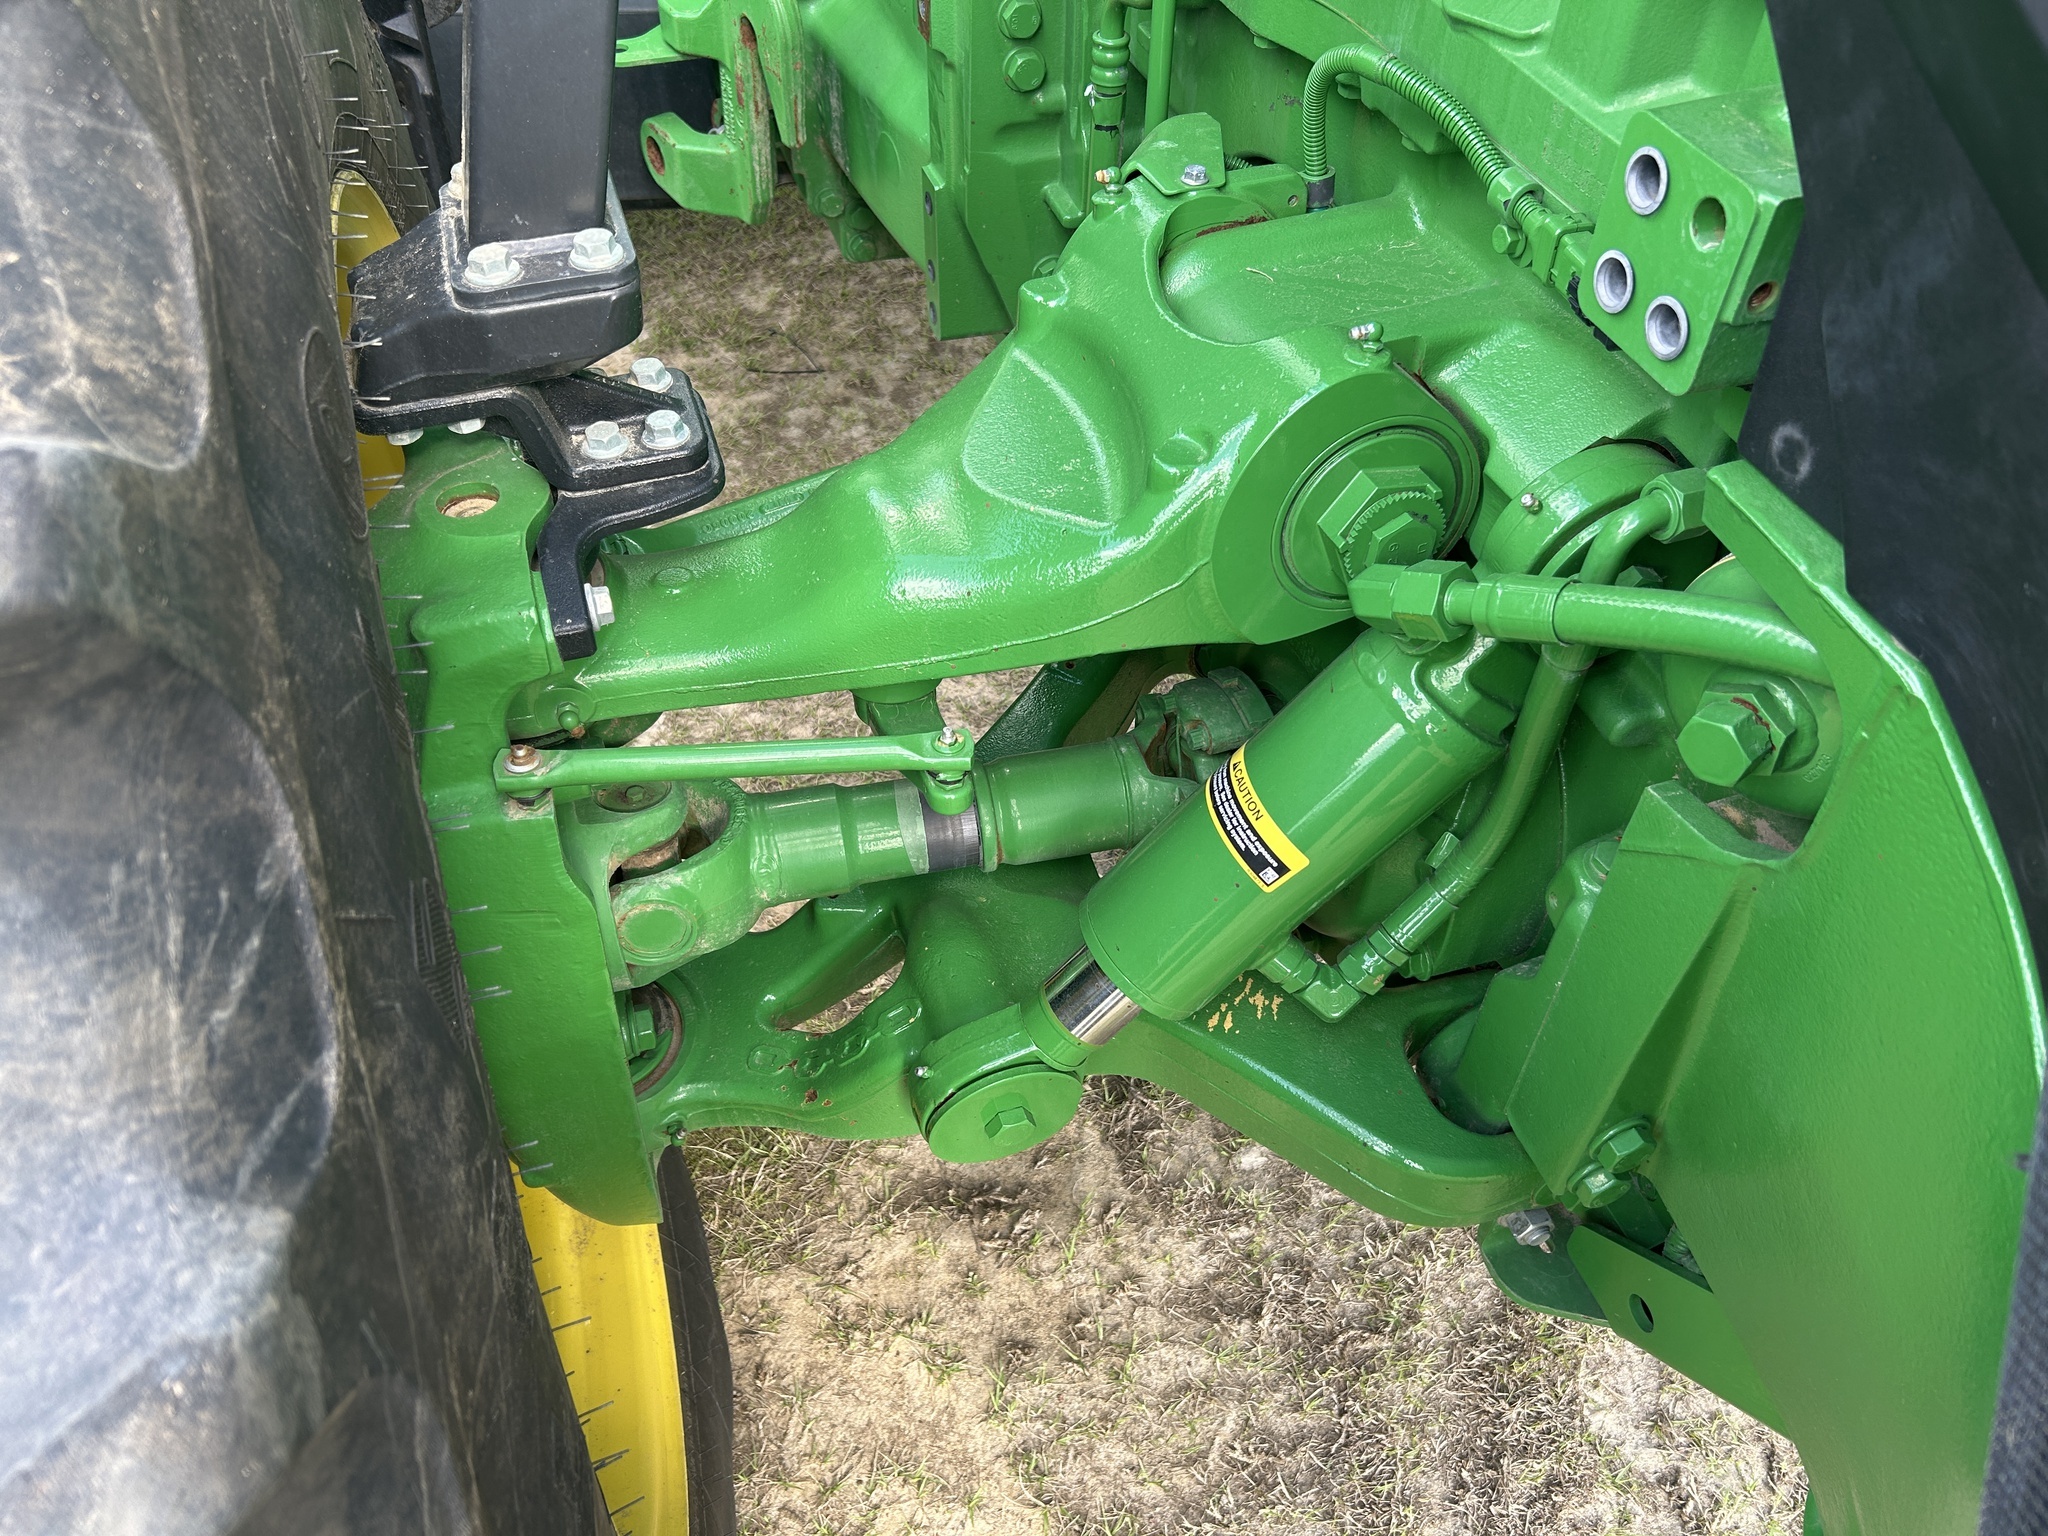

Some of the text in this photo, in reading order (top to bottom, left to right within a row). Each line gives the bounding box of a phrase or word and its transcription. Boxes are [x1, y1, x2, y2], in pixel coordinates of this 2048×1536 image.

[1223, 776, 1233, 800] machine
[1229, 798, 1249, 831] movement
[1246, 829, 1258, 842] and
[1254, 841, 1279, 867] exposure
[1234, 768, 1264, 821] CAUTION
[1218, 804, 1233, 831] servicing
[1230, 829, 1246, 852] system.
[1223, 801, 1235, 819] dealer
[1231, 817, 1239, 827] for
[1236, 825, 1259, 856] instruction
